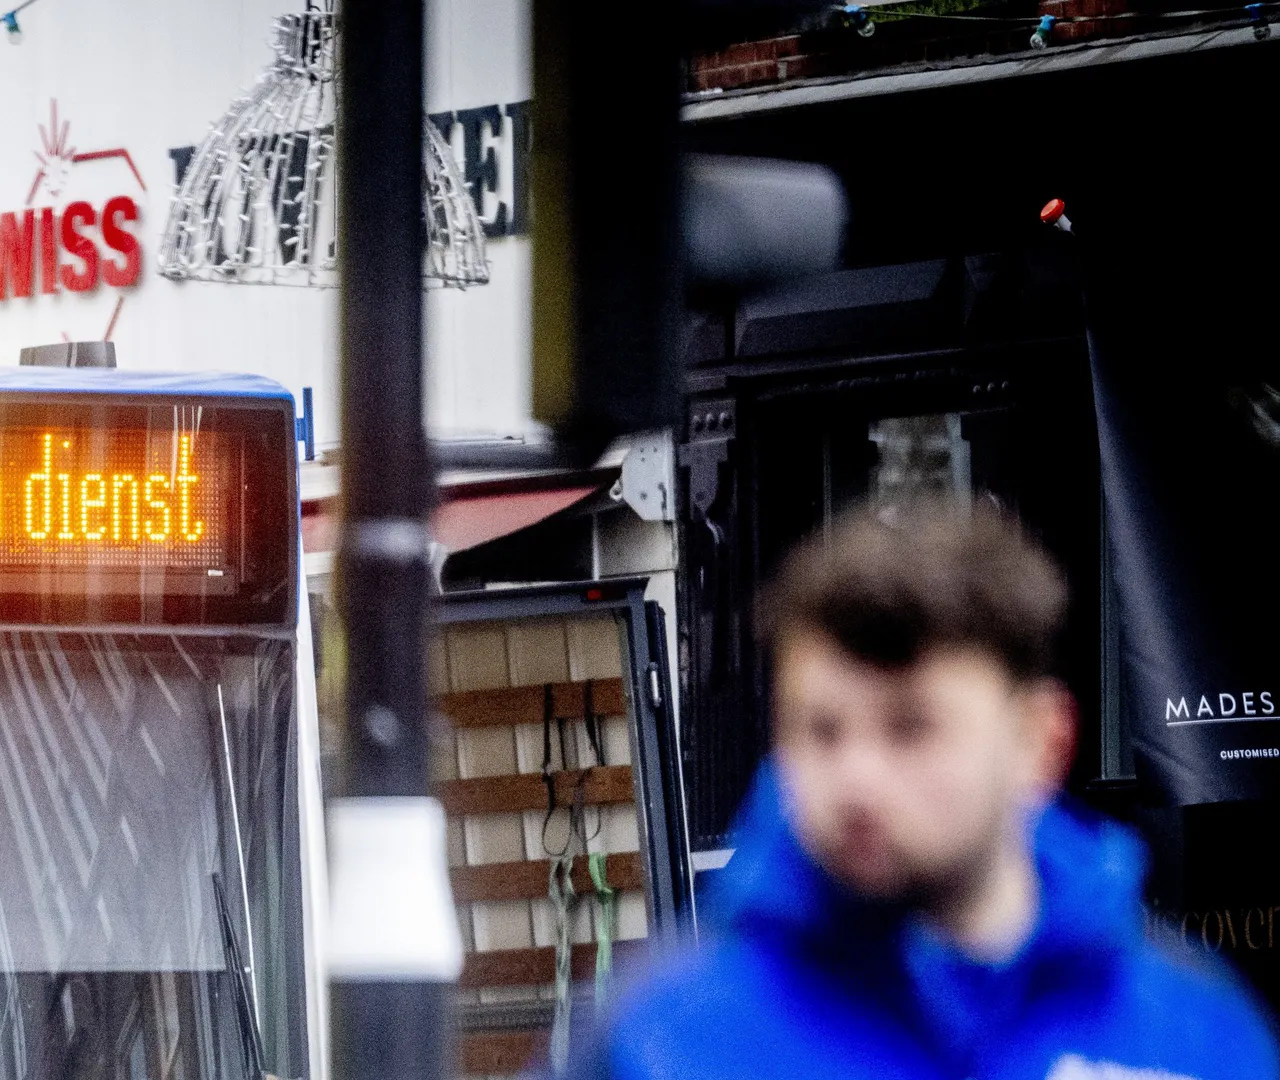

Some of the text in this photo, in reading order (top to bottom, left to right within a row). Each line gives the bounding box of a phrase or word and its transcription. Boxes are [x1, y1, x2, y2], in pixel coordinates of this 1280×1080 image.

[23, 432, 204, 543] dienst
[1165, 691, 1275, 721] MADES
[1220, 747, 1280, 760] CUSTOMISED
